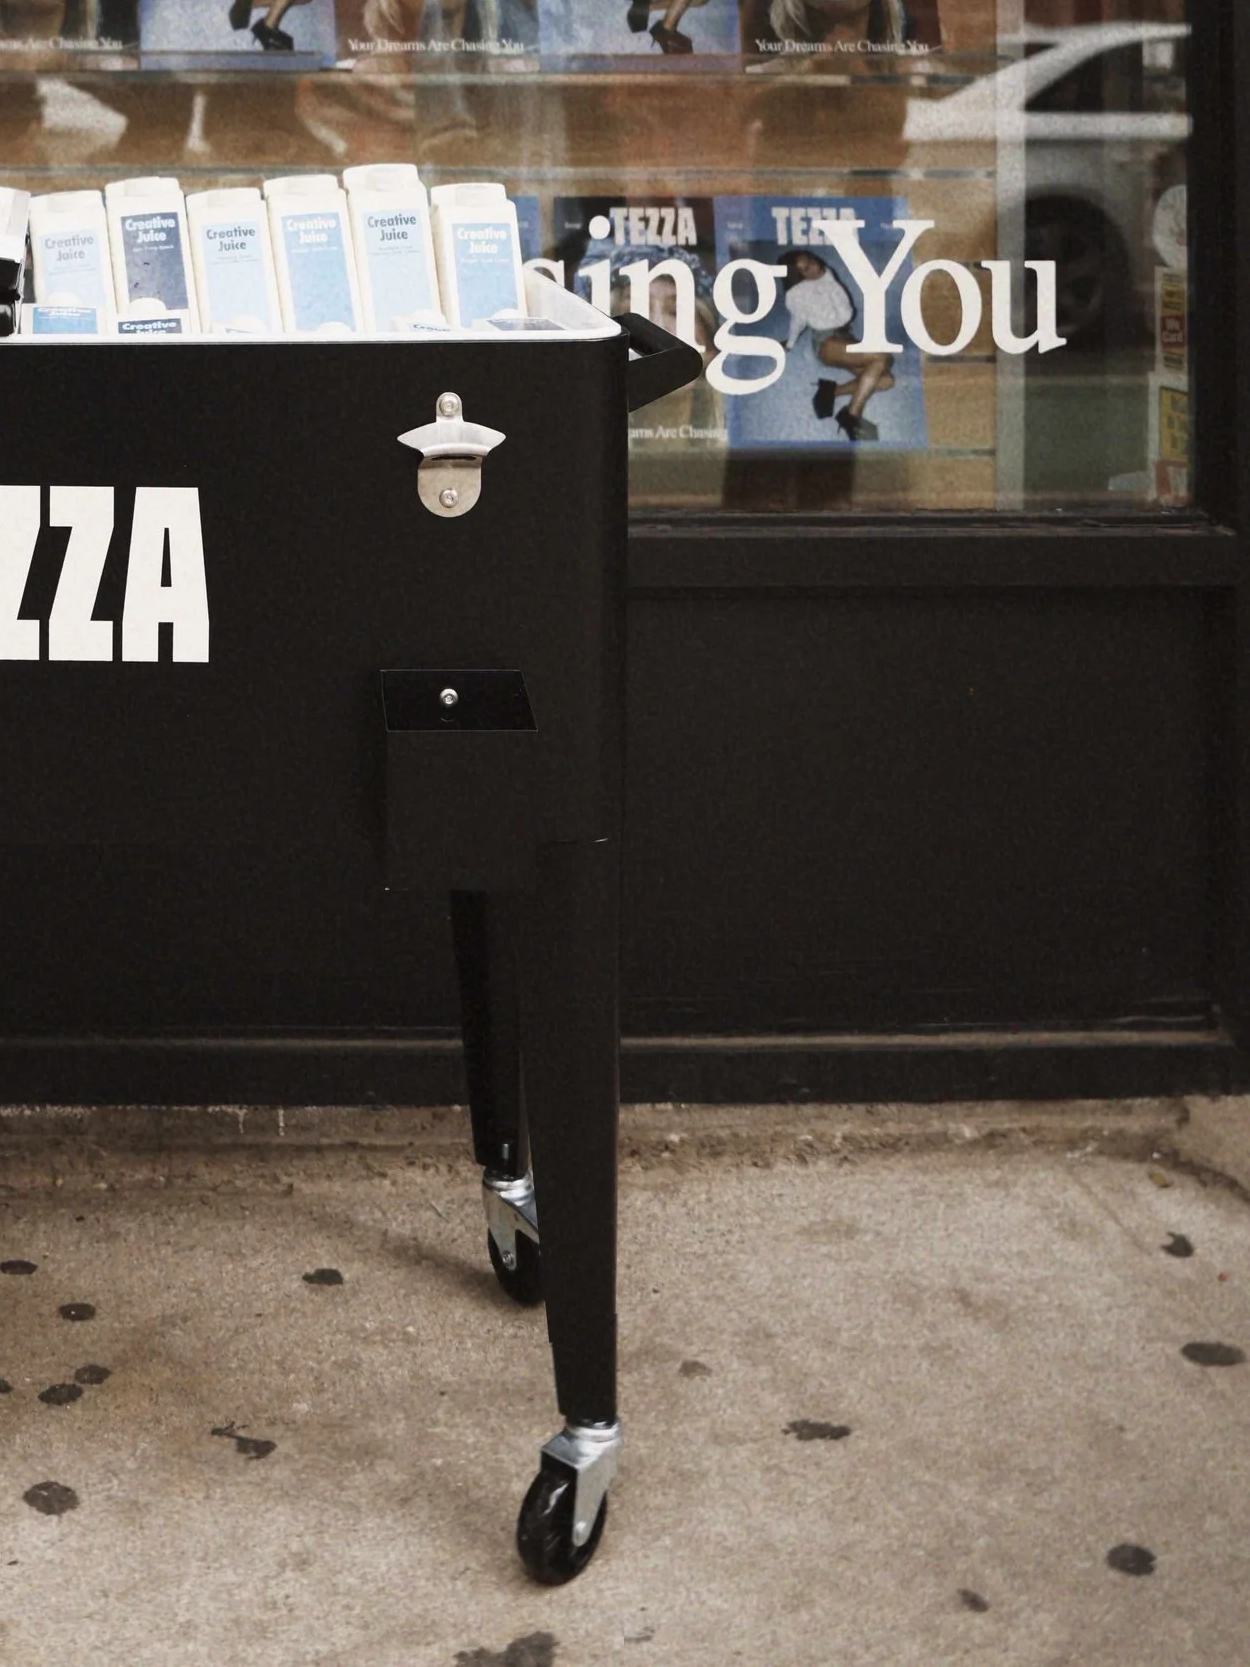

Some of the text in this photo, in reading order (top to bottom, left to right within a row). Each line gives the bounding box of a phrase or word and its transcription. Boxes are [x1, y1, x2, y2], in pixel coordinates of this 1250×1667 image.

[348, 39, 376, 51] Your
[377, 39, 426, 51] Dreams
[427, 39, 450, 51] Are
[755, 39, 783, 52] Your
[784, 39, 832, 52] Dreams
[834, 40, 856, 52] Are
[908, 41, 930, 54] You
[125, 216, 176, 231] Creative
[287, 216, 337, 231] Creative
[367, 214, 417, 228] Creative
[609, 206, 697, 246] TEZZA
[136, 229, 167, 243] Juice
[206, 226, 256, 240] Creative
[299, 231, 328, 244] Juice
[379, 228, 408, 242] Juice
[458, 226, 507, 240] Creative
[45, 234, 94, 249] Creative
[218, 239, 247, 252] Juice
[469, 240, 498, 254] Juice
[56, 248, 85, 262] Juice
[813, 219, 1068, 356] You
